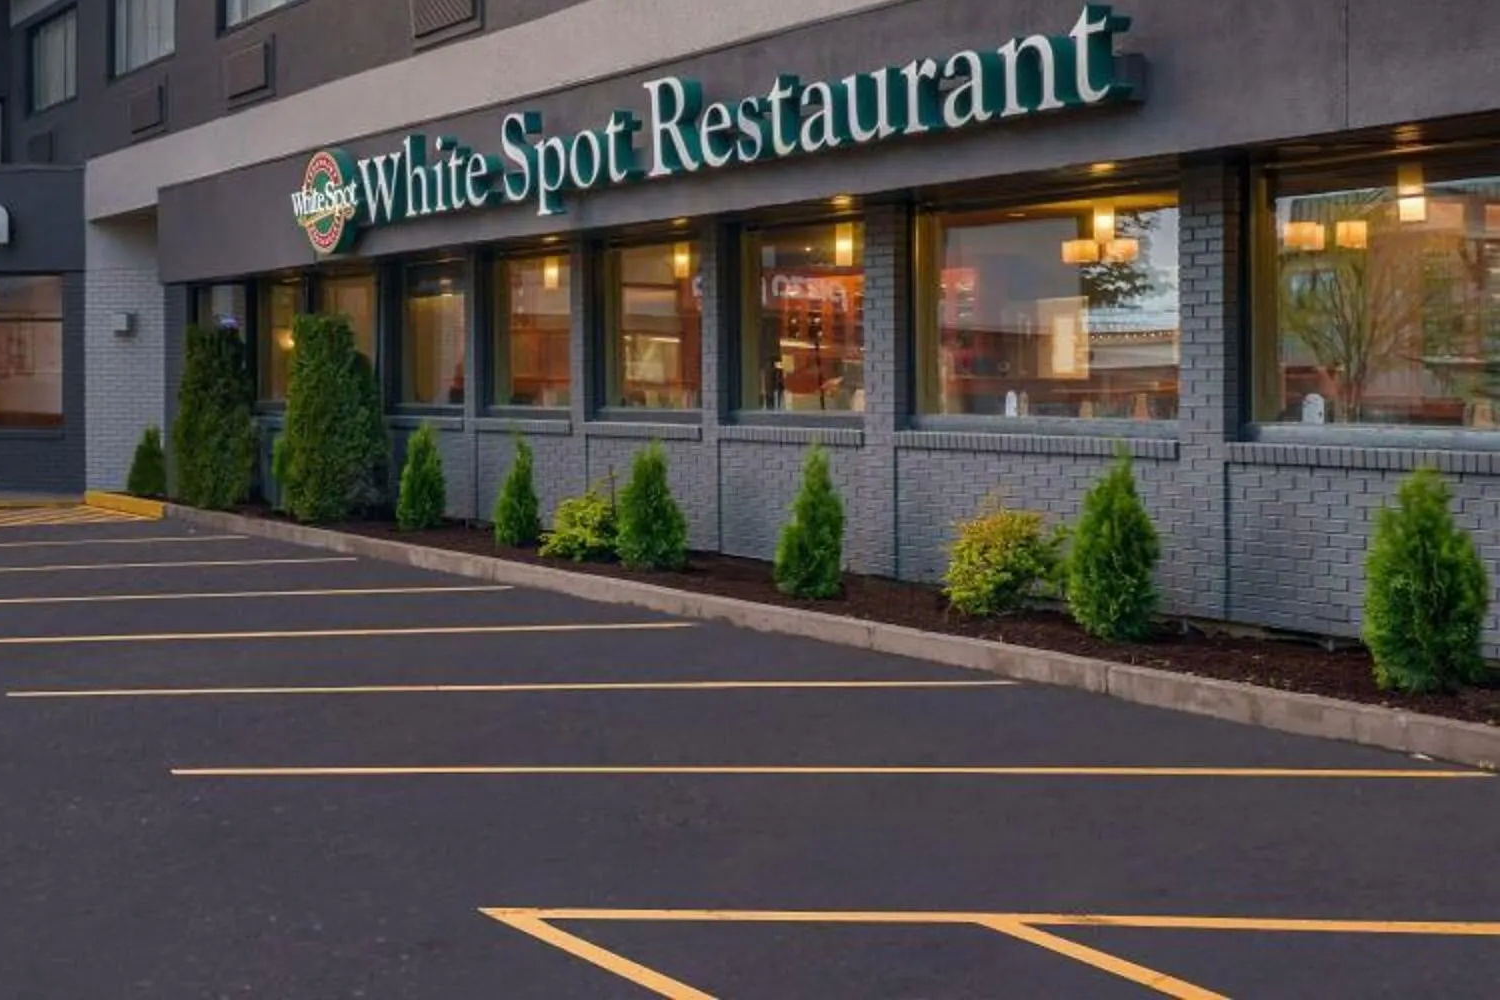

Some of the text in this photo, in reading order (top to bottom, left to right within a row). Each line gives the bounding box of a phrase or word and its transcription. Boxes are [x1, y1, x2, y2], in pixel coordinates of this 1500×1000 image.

[357, 4, 1111, 225] White Spot Restaurant
